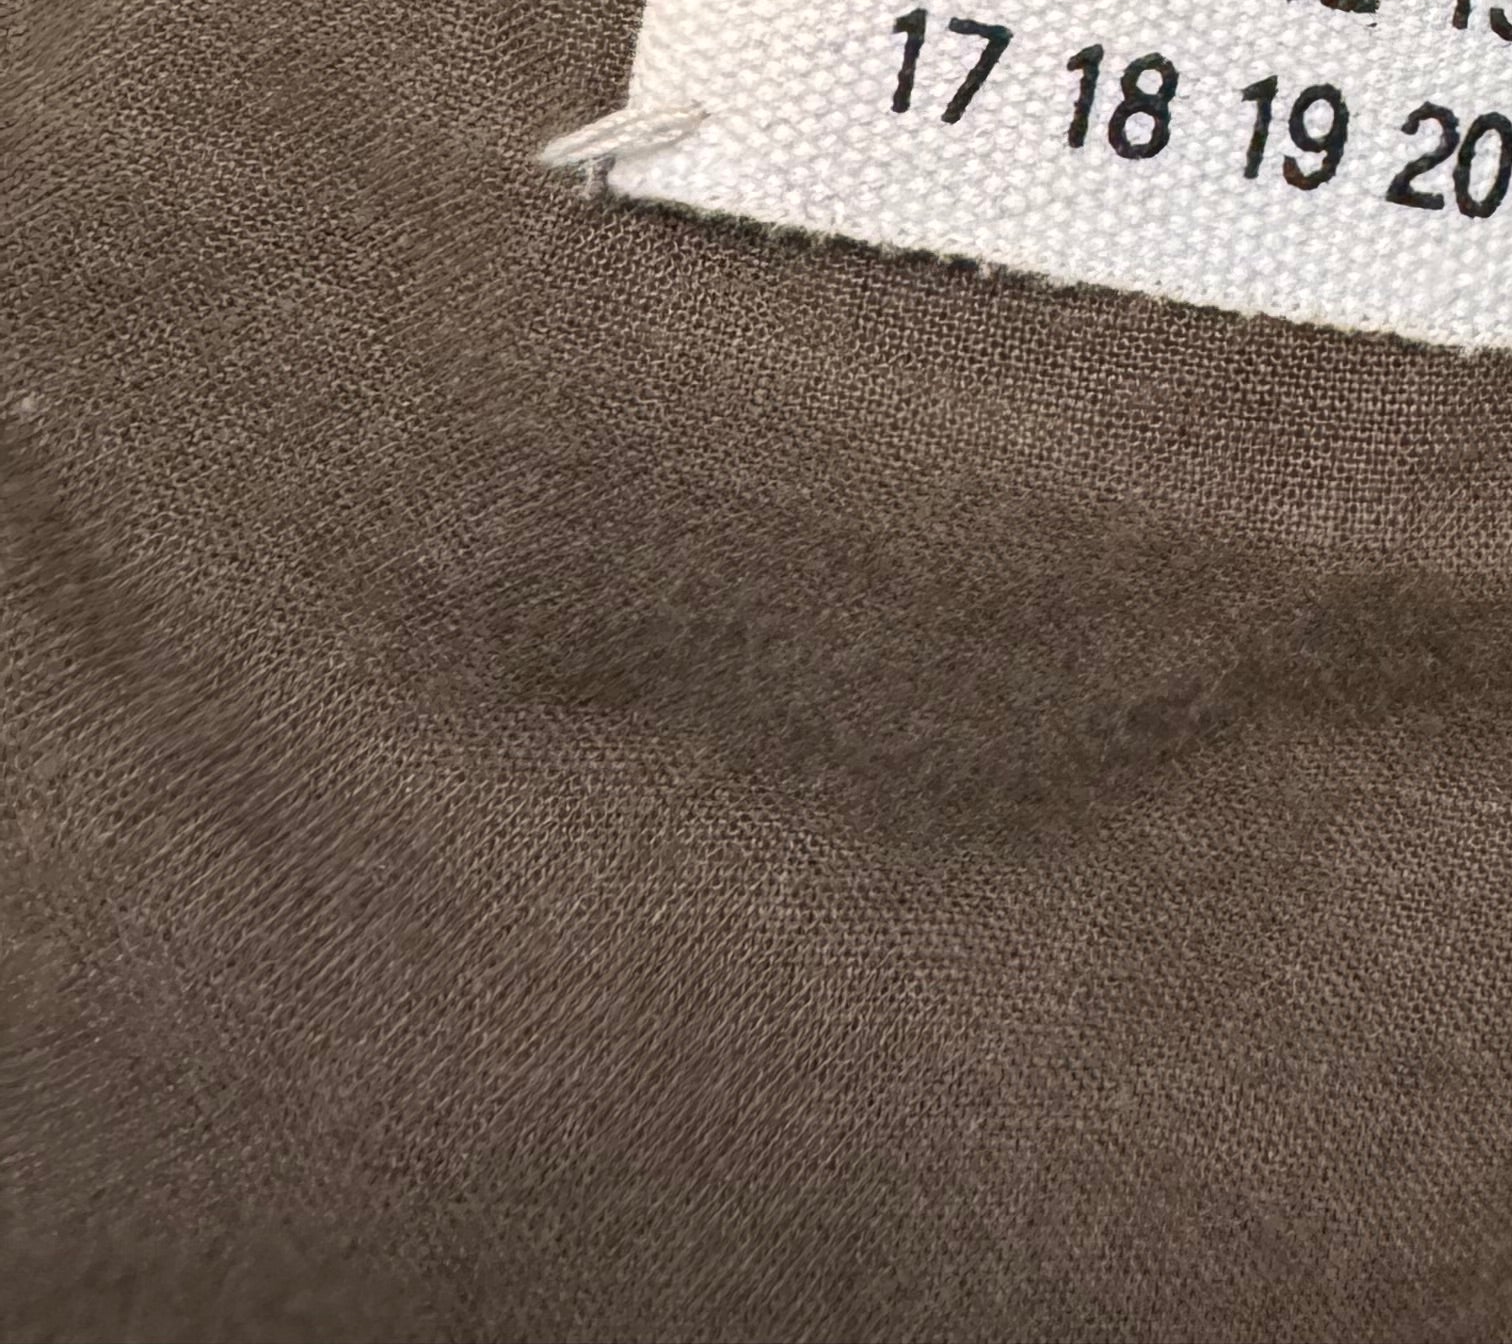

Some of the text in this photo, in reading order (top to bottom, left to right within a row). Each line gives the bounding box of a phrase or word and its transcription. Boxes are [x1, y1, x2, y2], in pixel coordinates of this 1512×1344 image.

[892, 9, 1013, 124] 17
[1067, 45, 1179, 160] 18
[1242, 76, 1349, 190] 19
